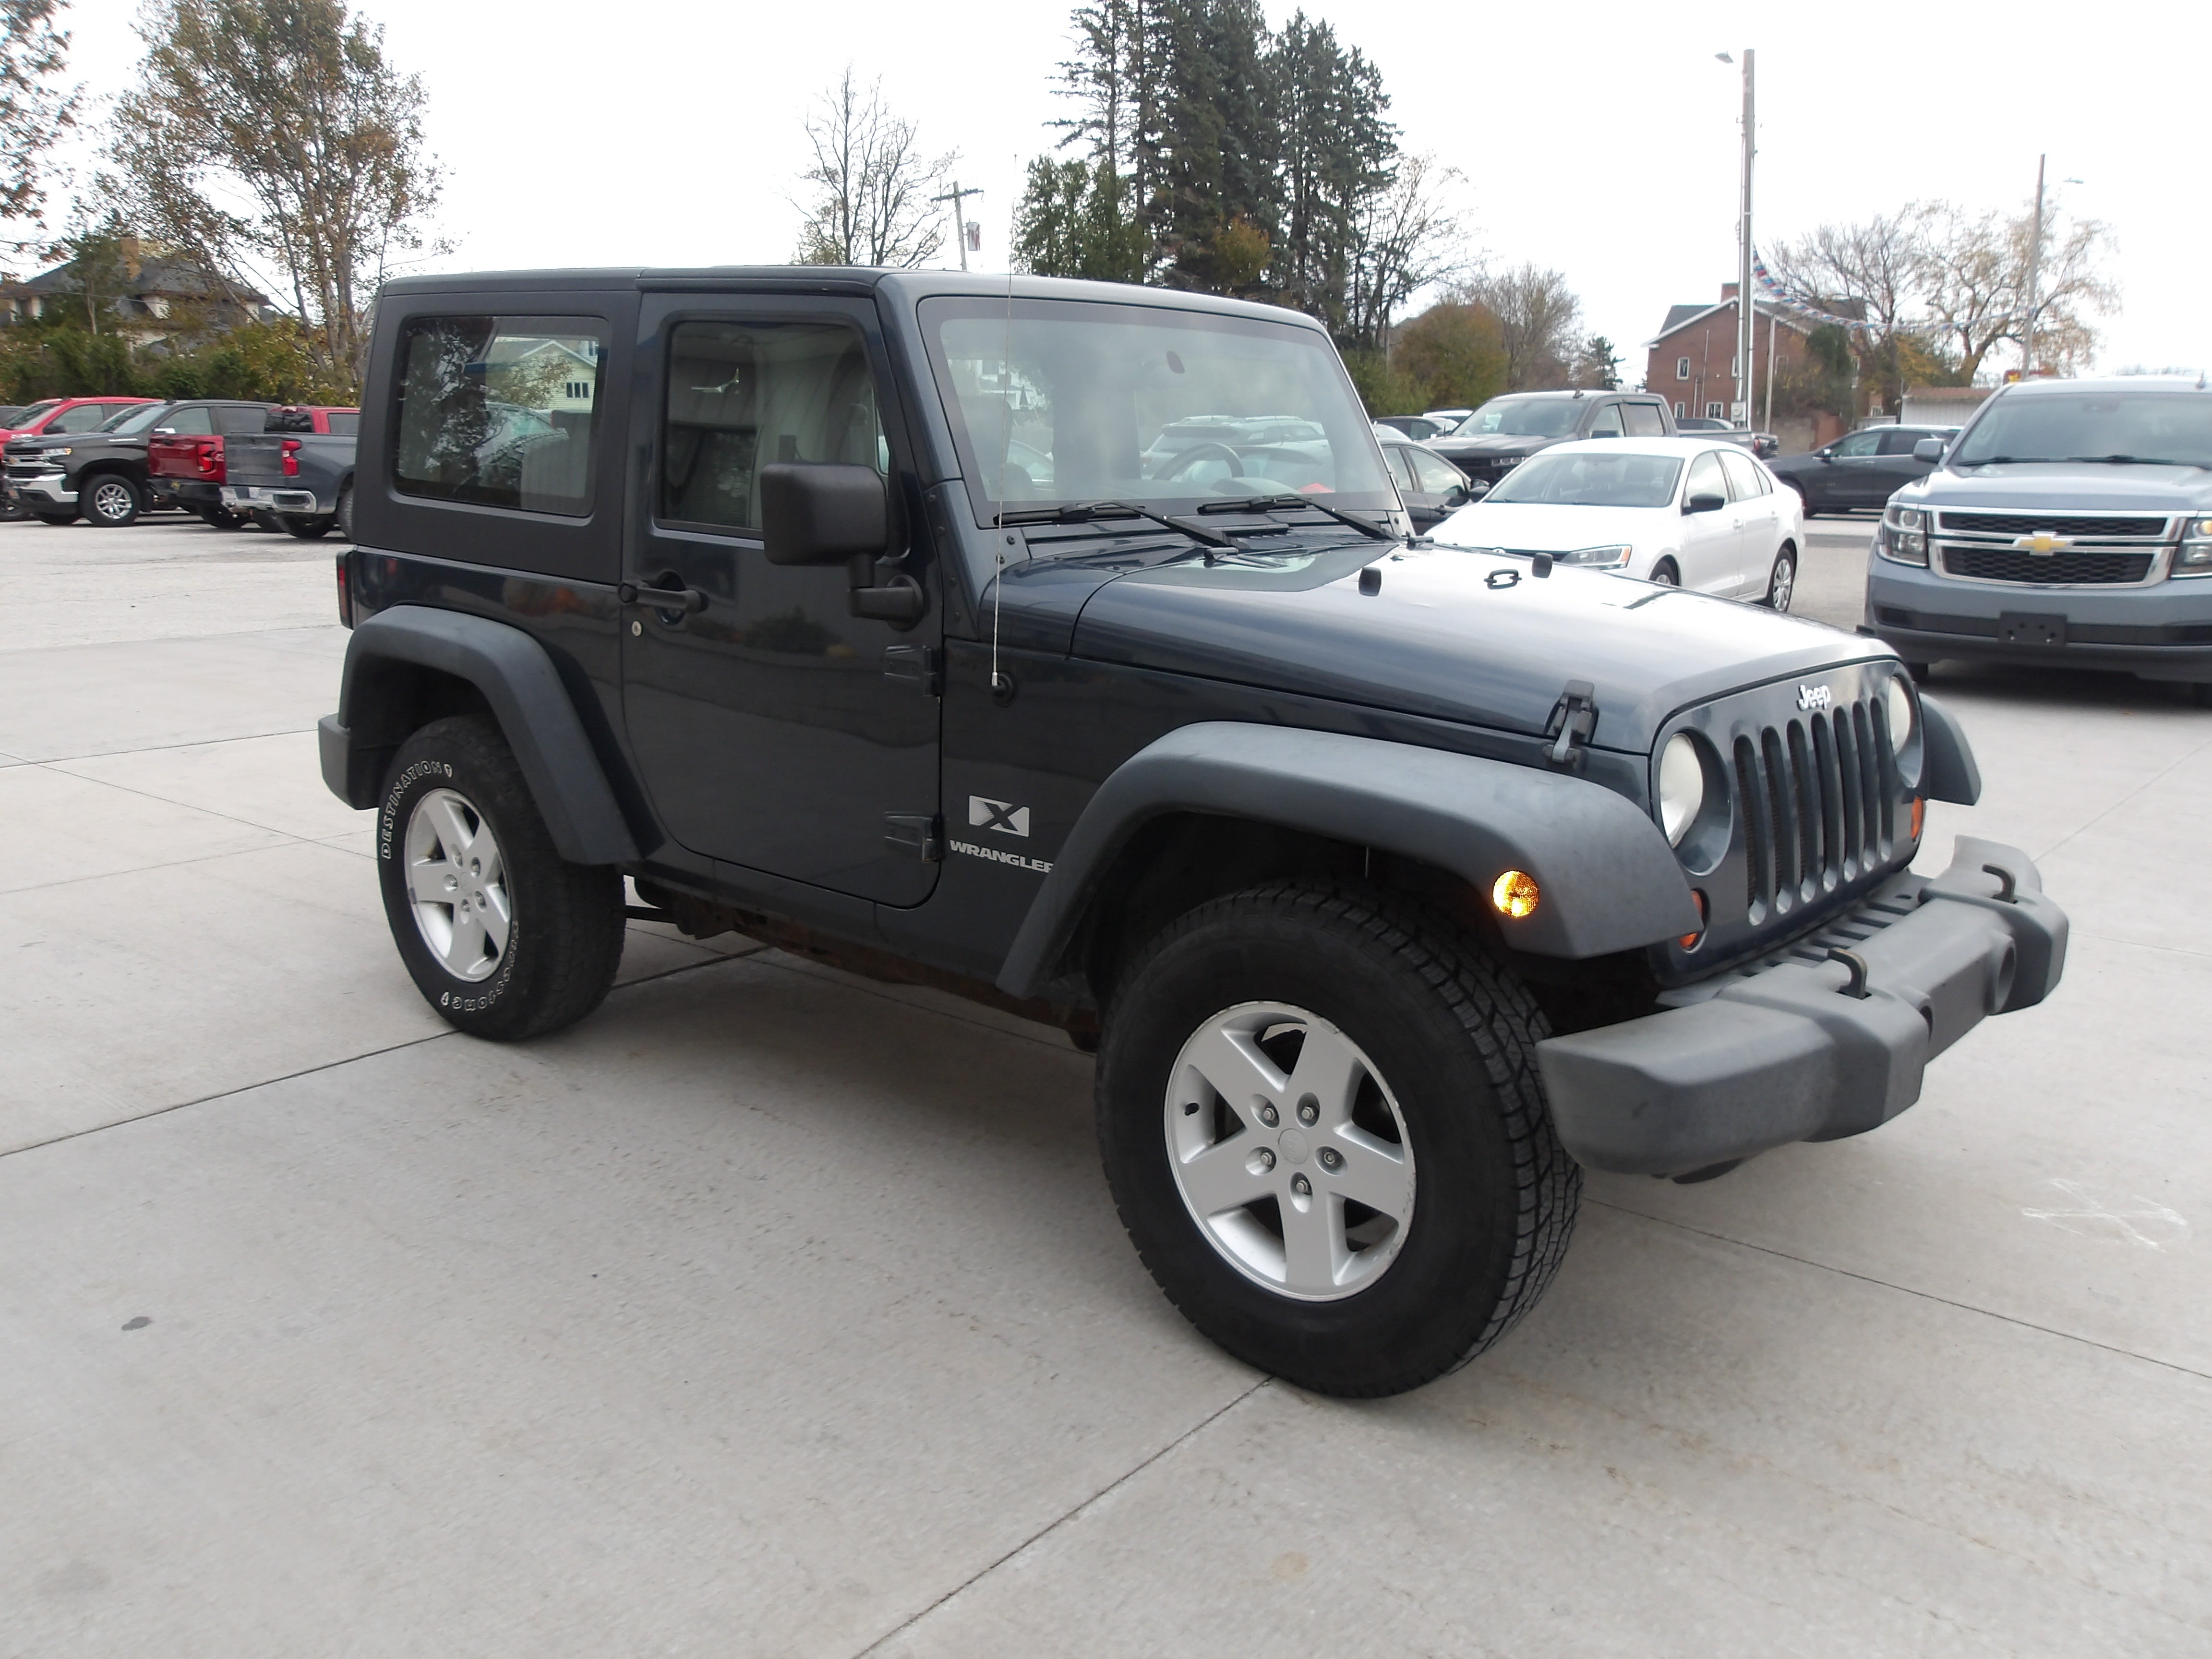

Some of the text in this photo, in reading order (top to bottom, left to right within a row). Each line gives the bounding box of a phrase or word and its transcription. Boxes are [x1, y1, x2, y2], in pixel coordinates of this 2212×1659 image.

[1797, 685, 1831, 710] Jeep
[382, 760, 443, 859] DESTINATION
[969, 795, 1029, 837] X
